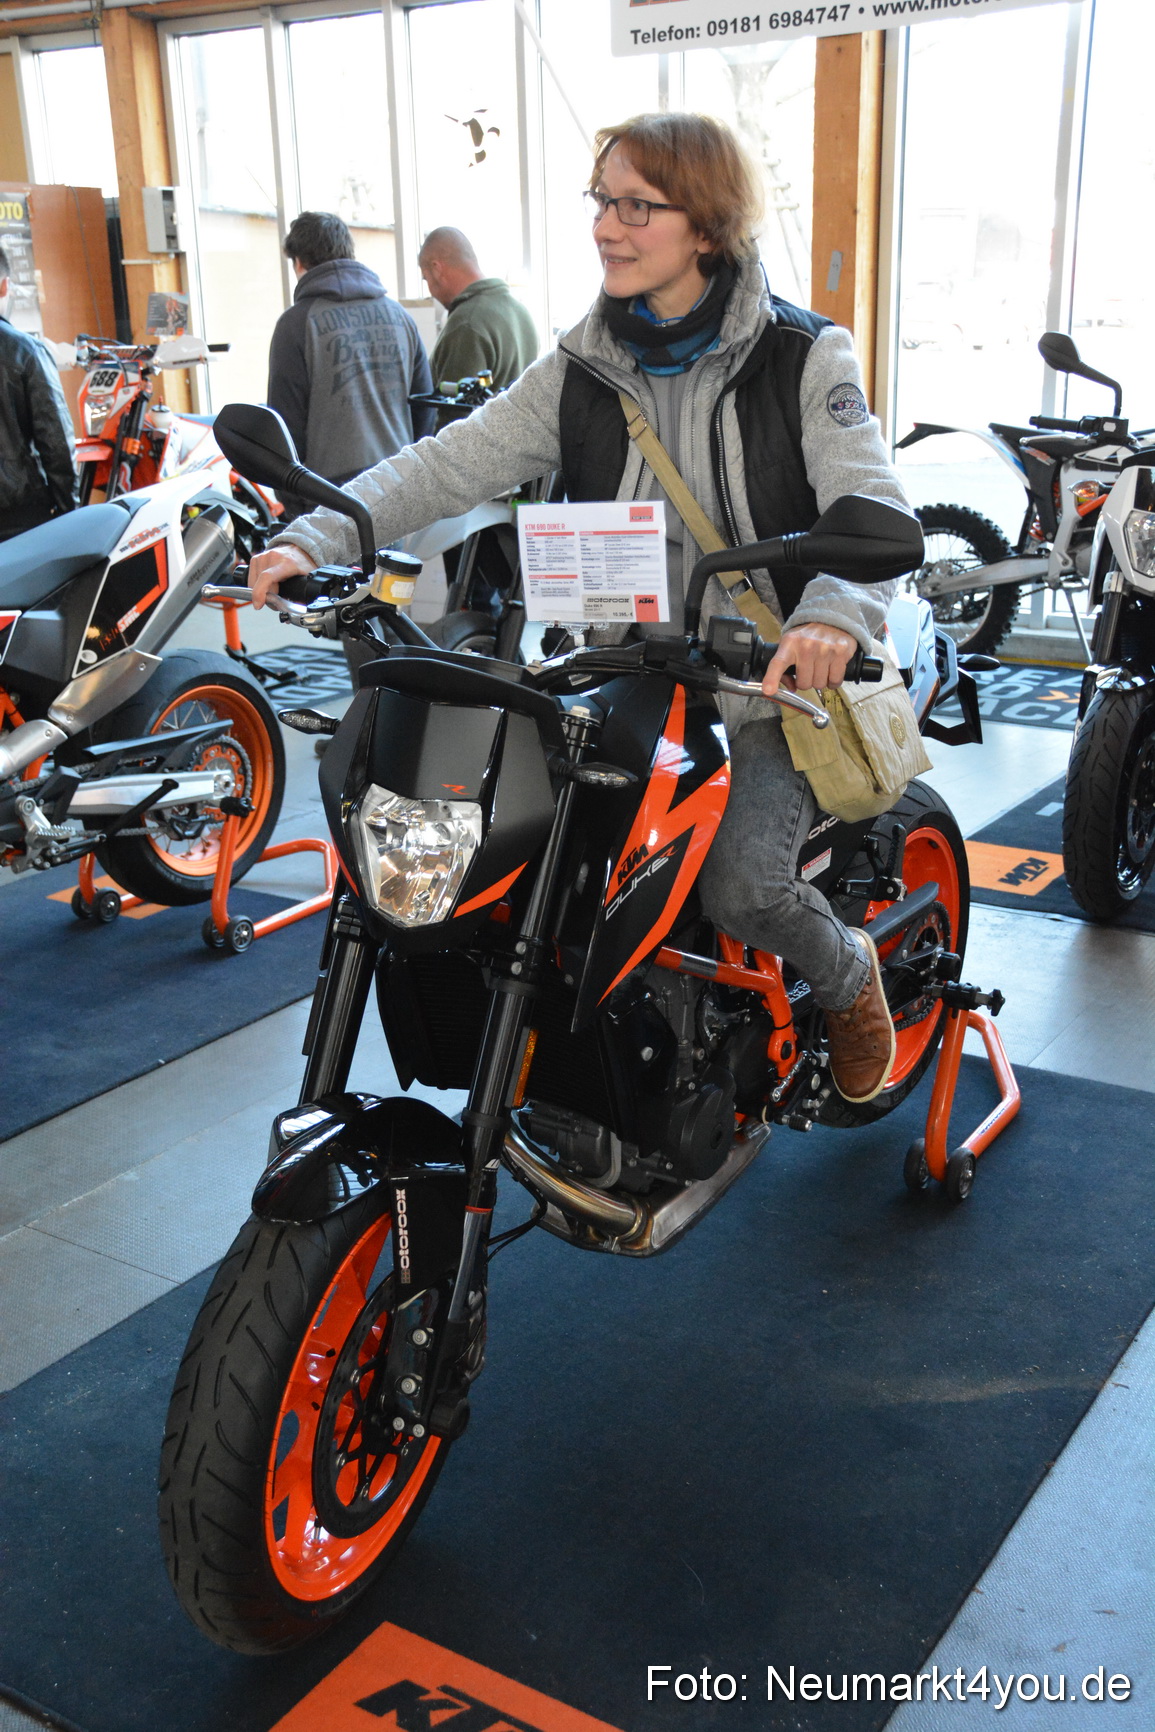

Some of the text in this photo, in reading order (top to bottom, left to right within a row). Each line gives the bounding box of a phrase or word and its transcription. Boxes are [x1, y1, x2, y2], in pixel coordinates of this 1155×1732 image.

[630, 26, 701, 45] Telefon:
[706, 15, 761, 37] 09181
[768, 6, 851, 30] 6984747
[89, 370, 120, 387] 688
[617, 843, 650, 887] KTM
[998, 857, 1050, 888] KTM
[605, 856, 669, 921] DUKE
[396, 1188, 411, 1284] motoroox
[353, 1679, 549, 1732] KT
